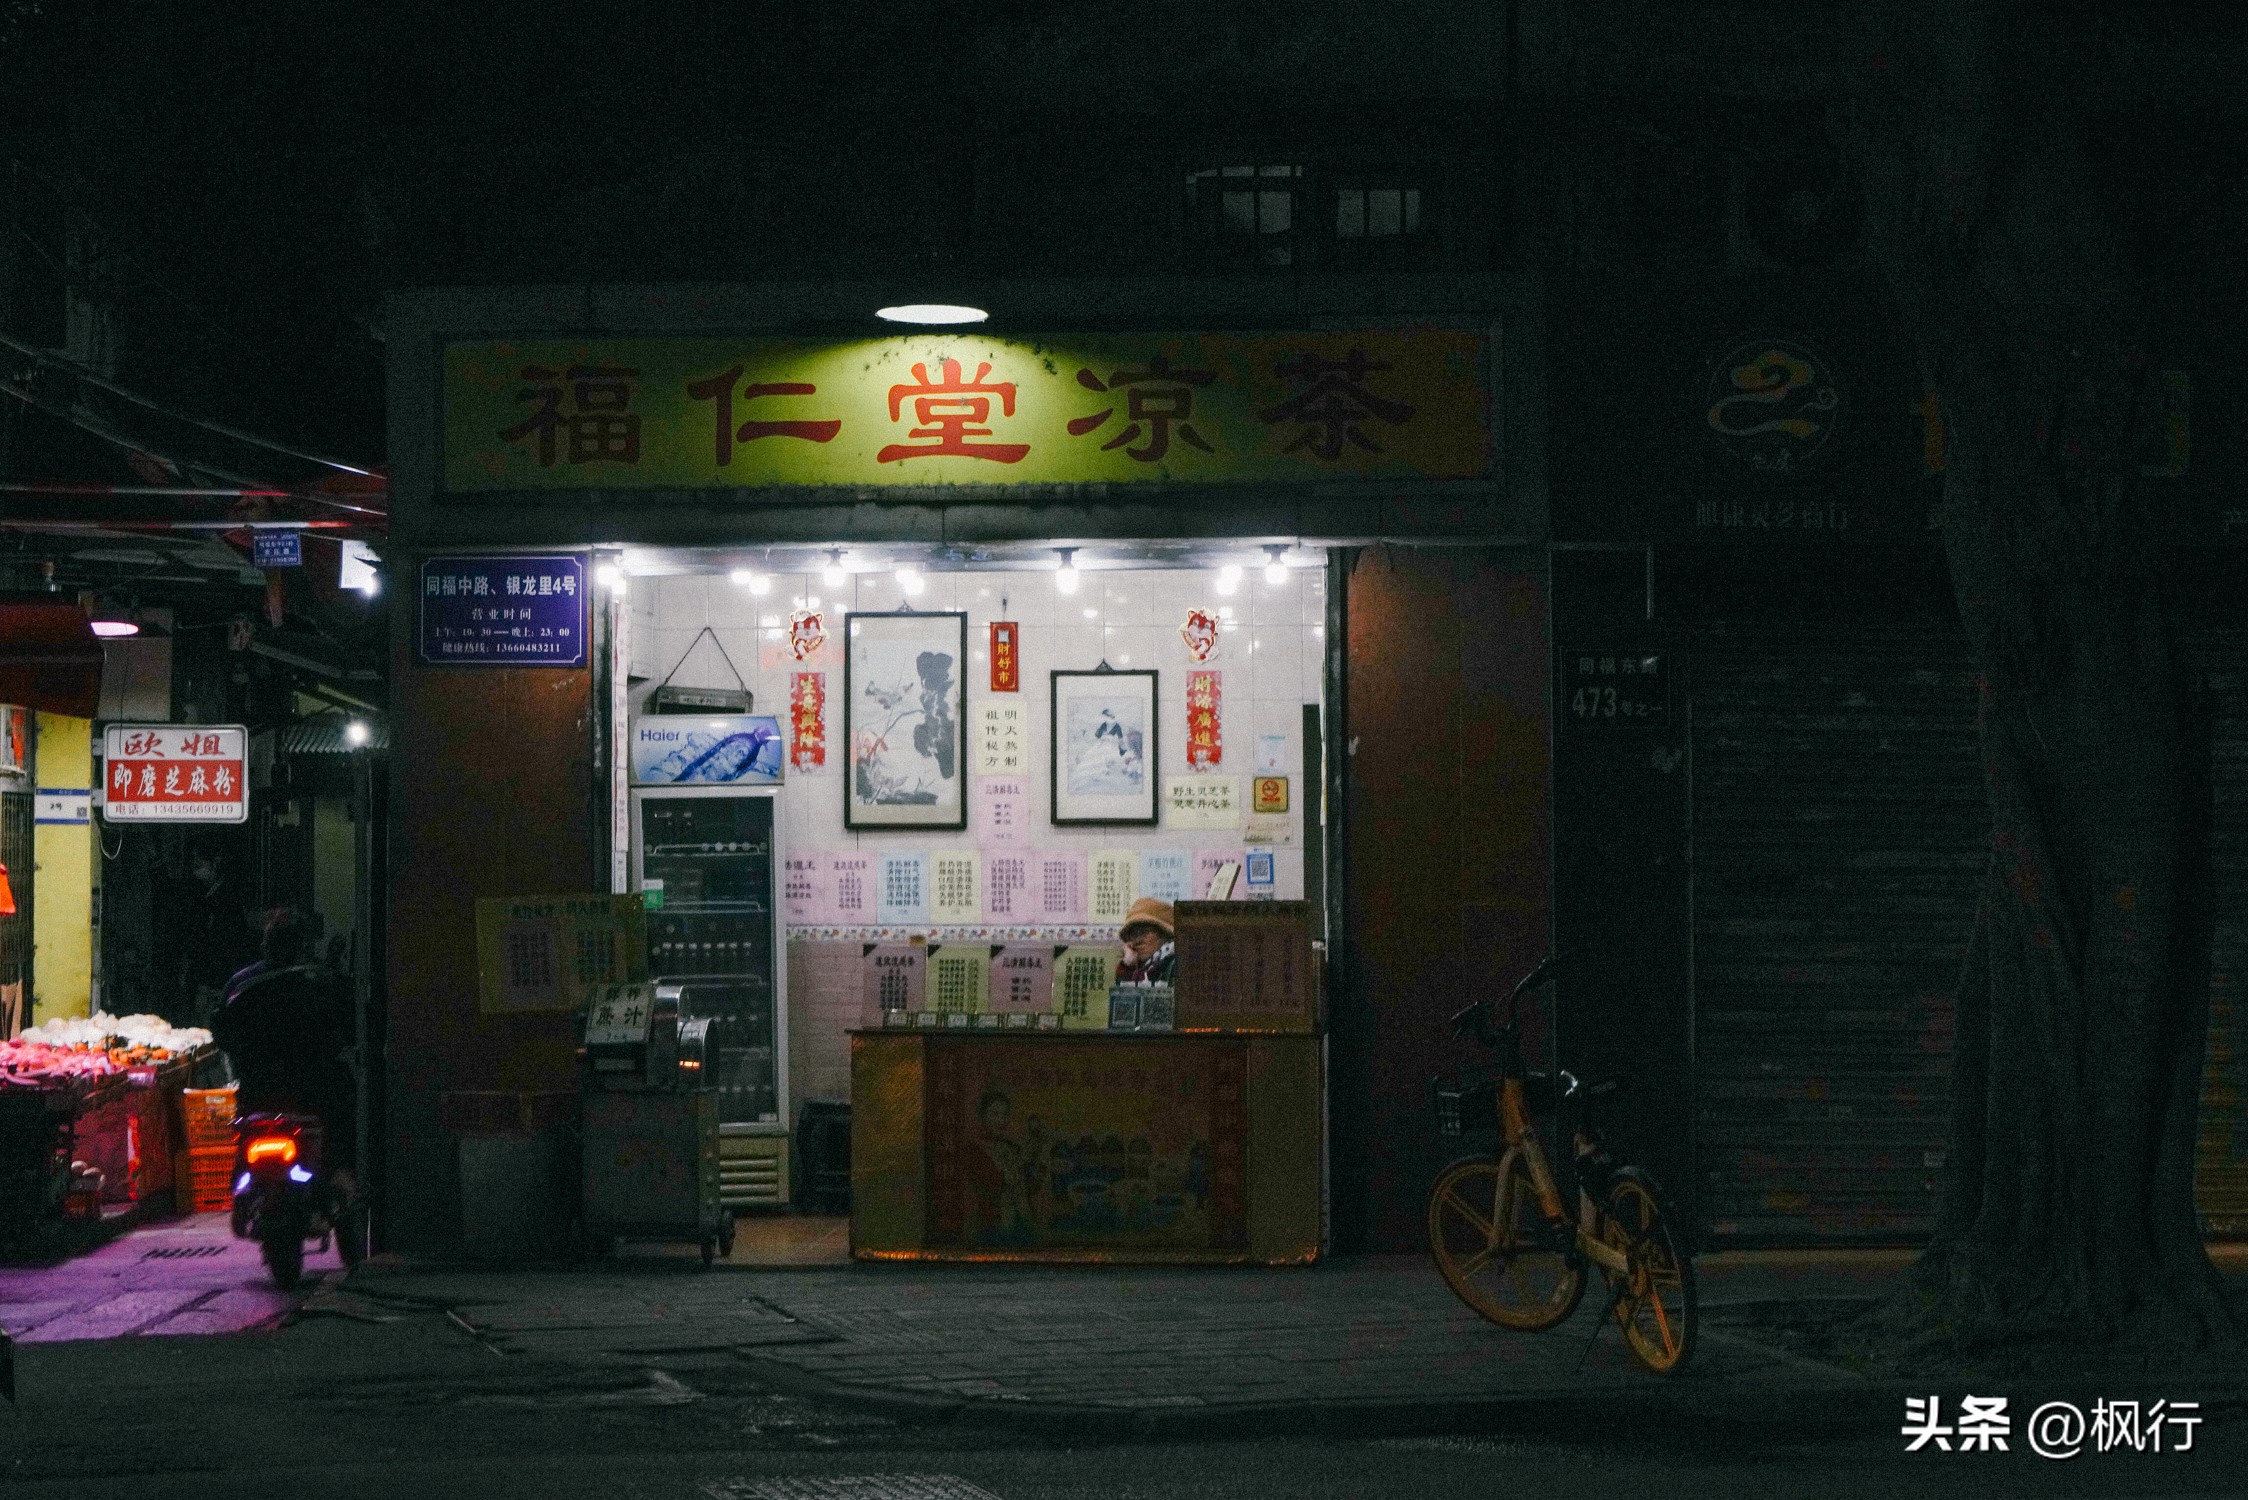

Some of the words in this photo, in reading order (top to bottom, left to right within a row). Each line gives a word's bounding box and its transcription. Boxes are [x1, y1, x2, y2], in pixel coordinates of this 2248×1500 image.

[499, 357, 1413, 468] 福仁堂凉茶
[426, 575, 577, 596] 同福中路、银龙里4号
[472, 607, 532, 621] 营业时间
[997, 631, 1012, 685] 財好市
[640, 729, 680, 742] Haier
[985, 710, 999, 766] 祖传秘方
[114, 762, 236, 799] 即磨芝麻粉
